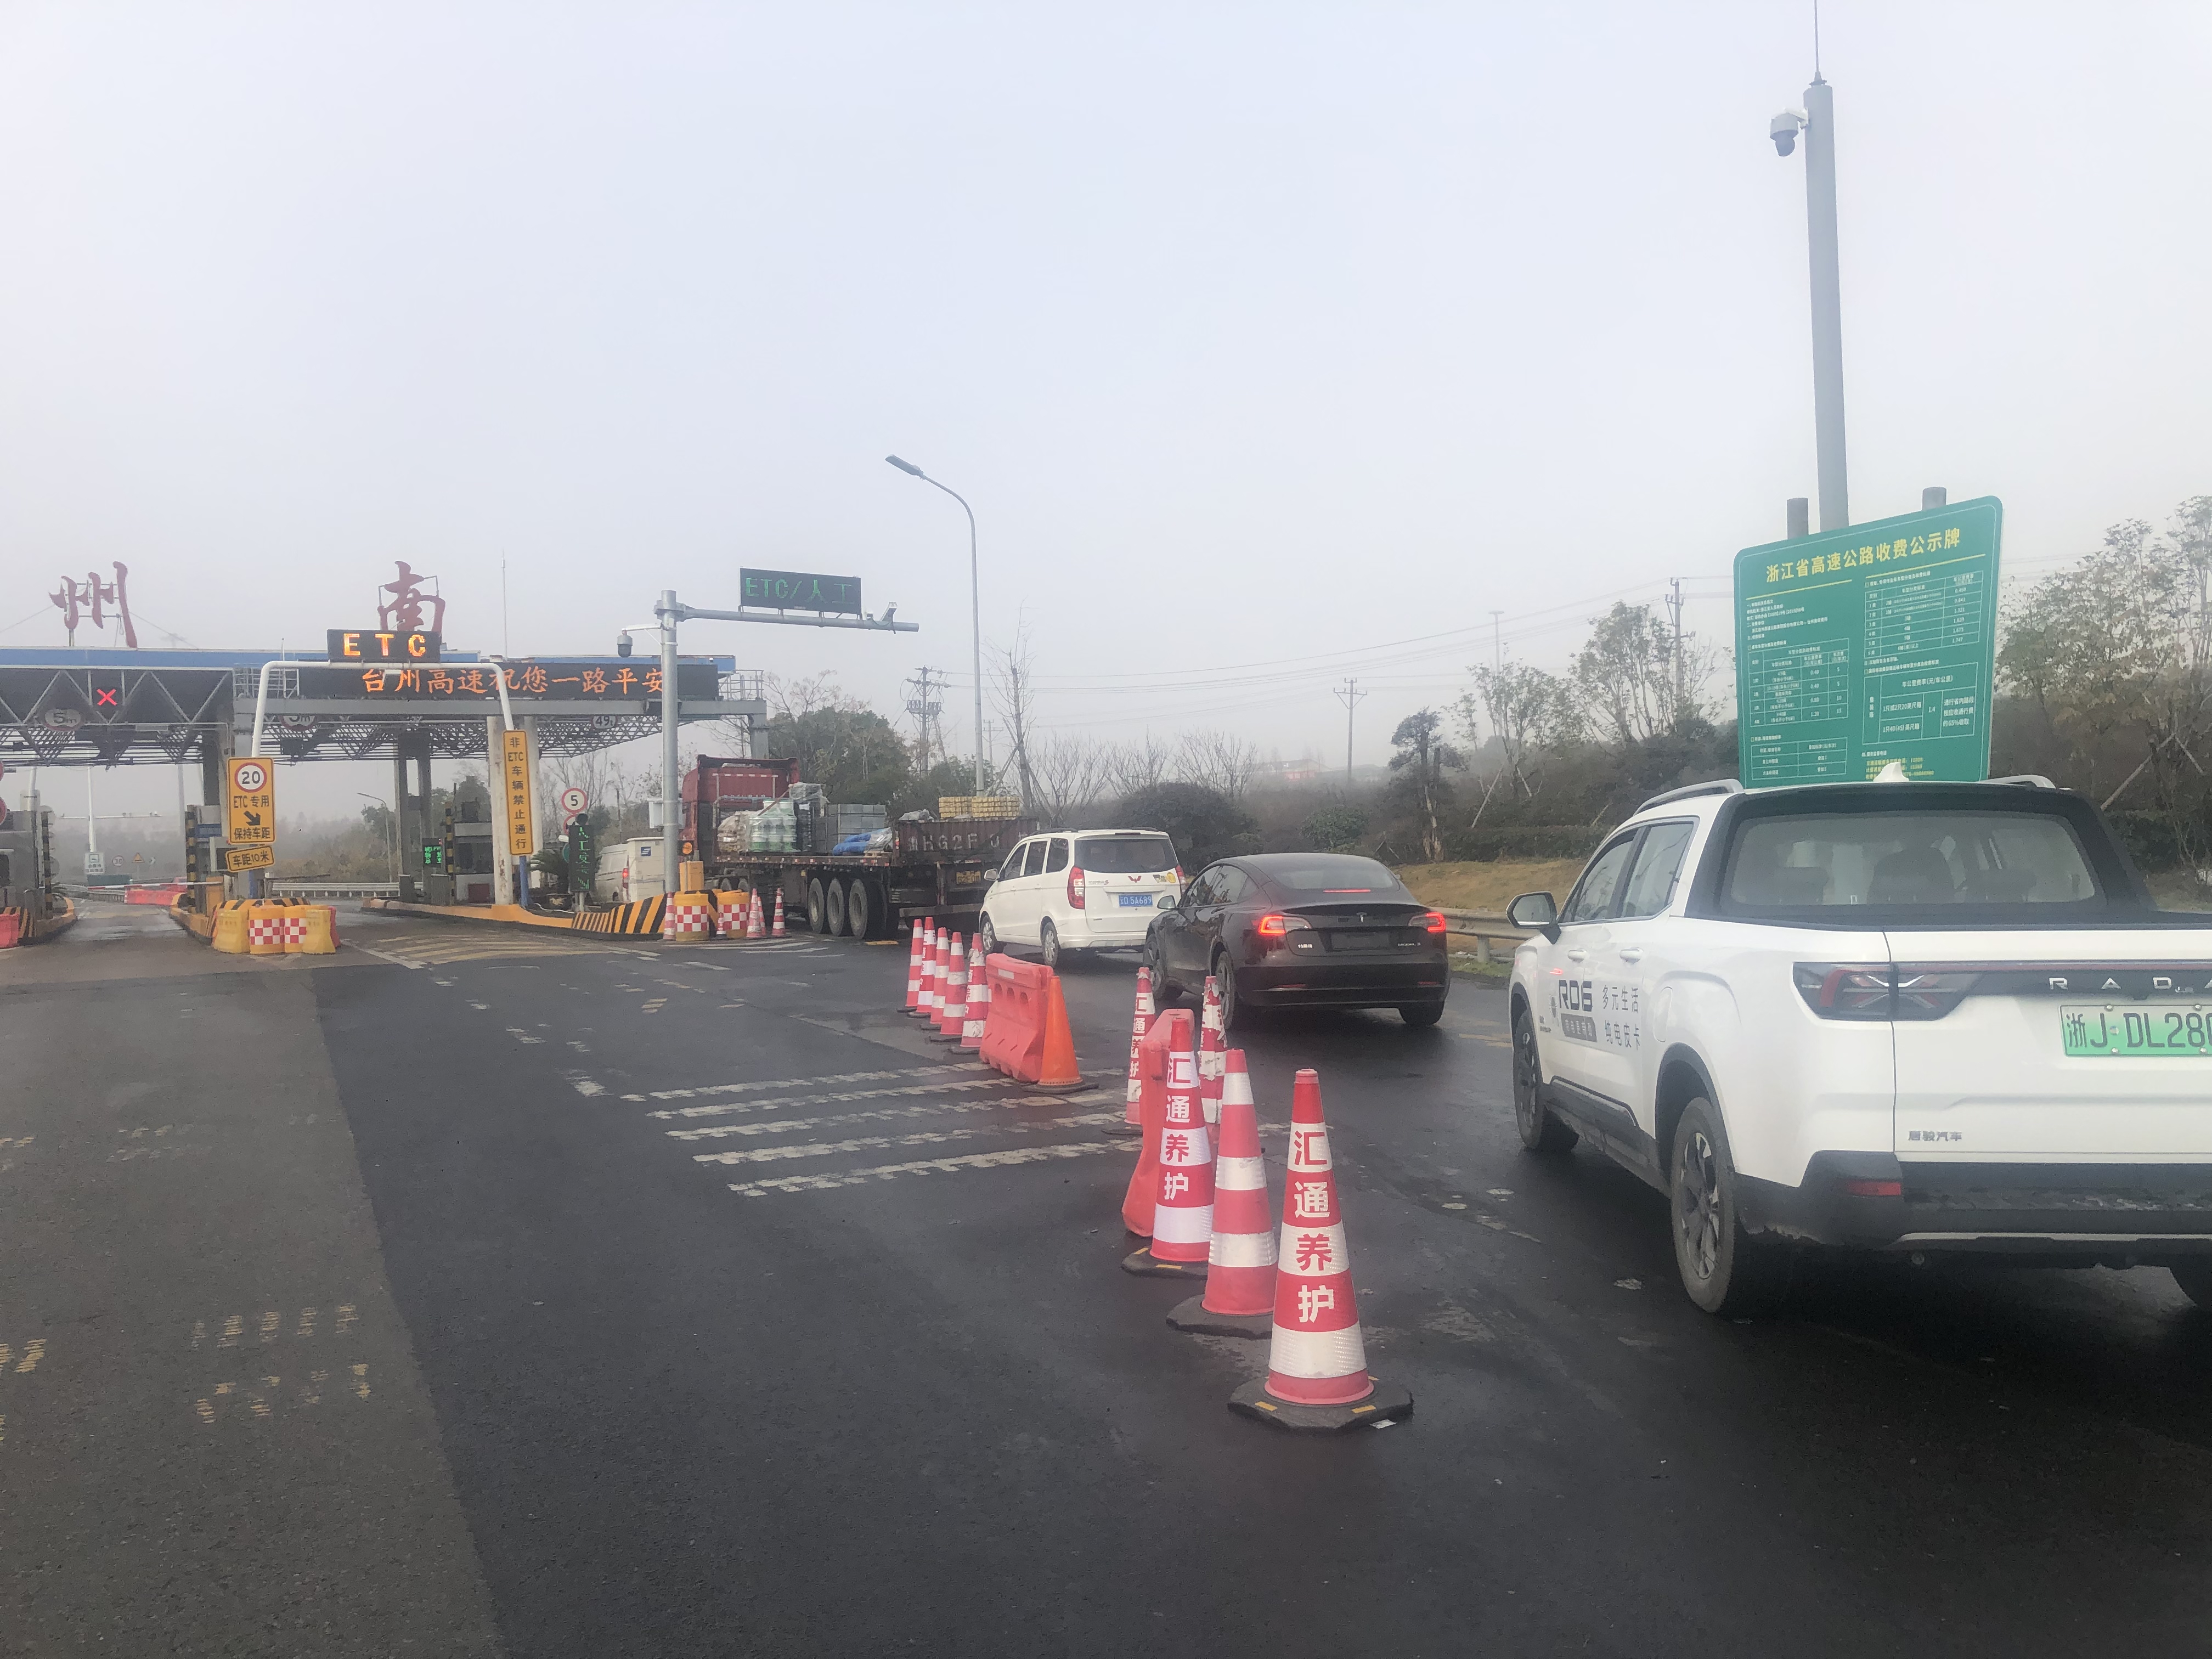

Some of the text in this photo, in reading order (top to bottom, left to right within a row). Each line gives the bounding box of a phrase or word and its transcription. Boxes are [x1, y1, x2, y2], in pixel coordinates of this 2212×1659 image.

[1766, 527, 1960, 583] 浙江省高速公路收费公示牌
[48, 561, 445, 648] 州 南
[343, 633, 426, 657] ETC
[362, 665, 663, 695] 台州高速祝您一路平安
[241, 770, 261, 785] 20
[507, 736, 527, 849] 非ETC车辆禁止通行
[571, 794, 578, 806] 5
[234, 827, 270, 840] 保持车距
[232, 851, 269, 867] 车距10米
[1559, 979, 1593, 1012] RD6
[1602, 984, 1639, 1013] 多元生活
[1605, 1019, 1640, 1051] 纯电皮卡
[1164, 1058, 1190, 1200] 汇通养护
[1294, 1130, 1334, 1323] 汇通养护
